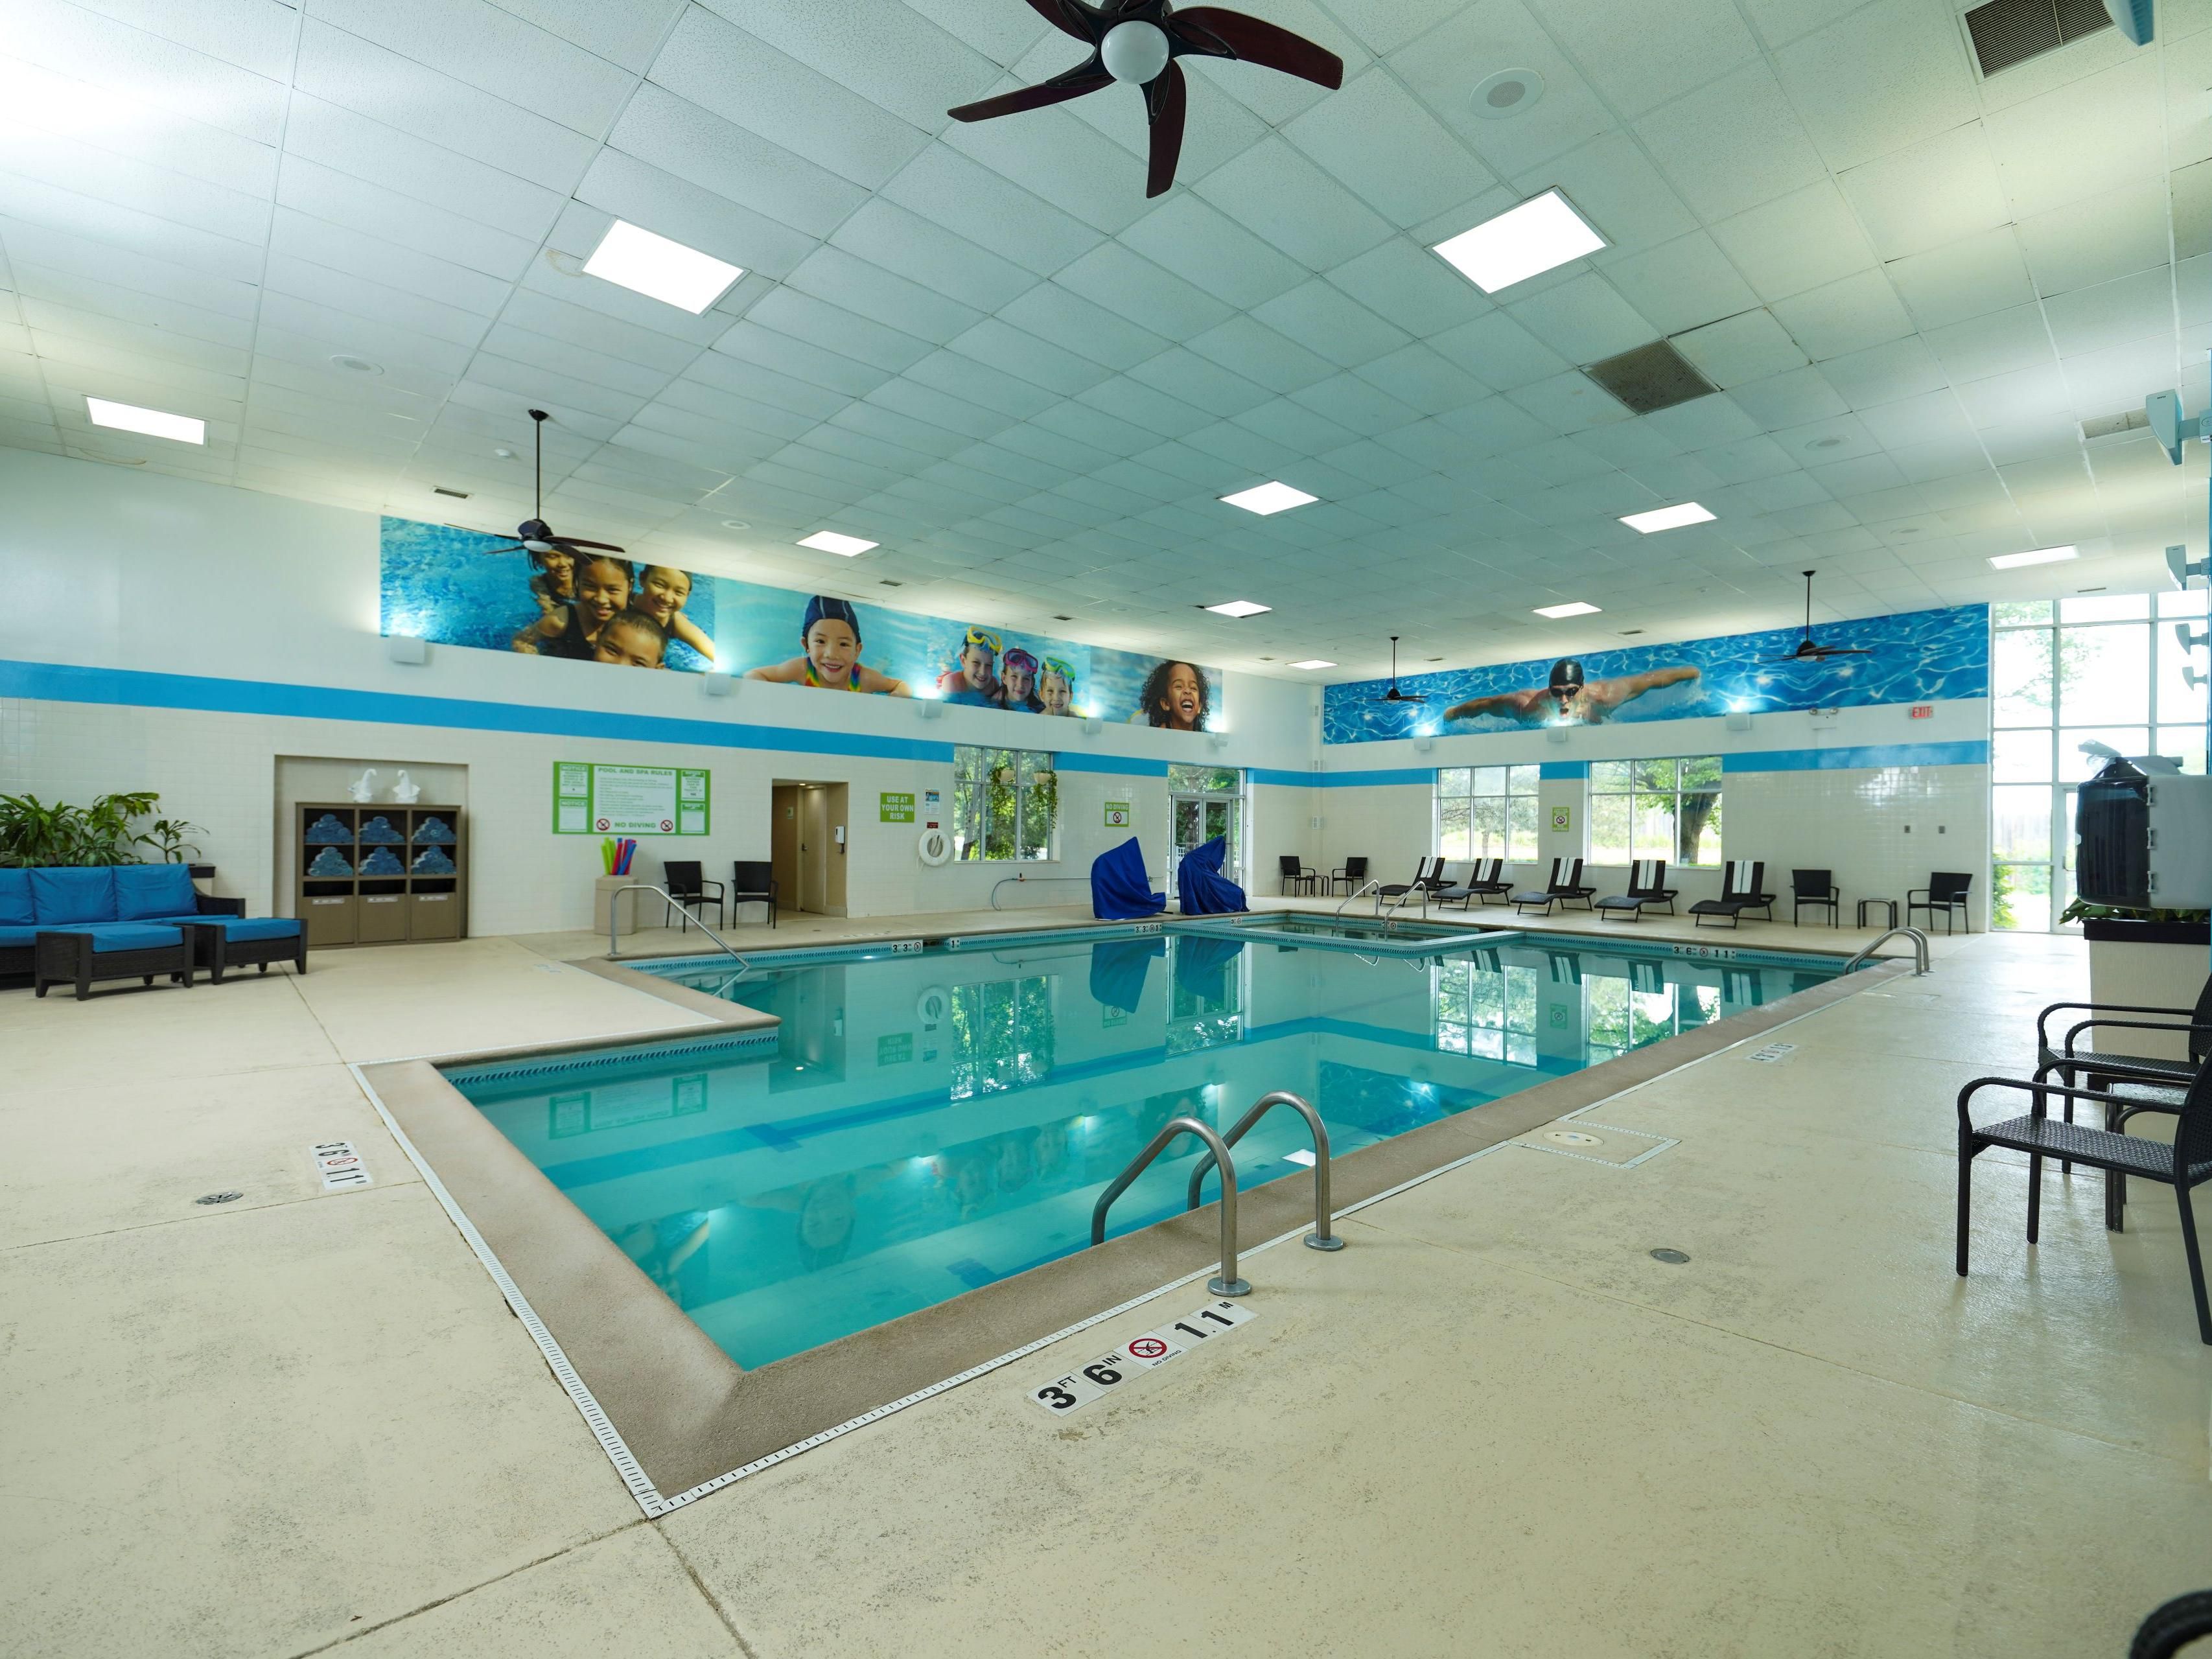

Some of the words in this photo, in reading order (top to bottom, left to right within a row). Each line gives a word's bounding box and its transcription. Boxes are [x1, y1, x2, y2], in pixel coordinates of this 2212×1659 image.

[1913, 706, 1931, 718] EXIT
[892, 944, 898, 953] 3
[903, 944, 908, 952] 3
[1673, 946, 1680, 955] 3
[1218, 1301, 1234, 1310] M
[1102, 1354, 1123, 1367] IN
[1162, 1349, 1183, 1362] DIVING
[1082, 1363, 1123, 1386] 6
[1057, 1376, 1077, 1388] FT
[1038, 1386, 1077, 1410] 3
